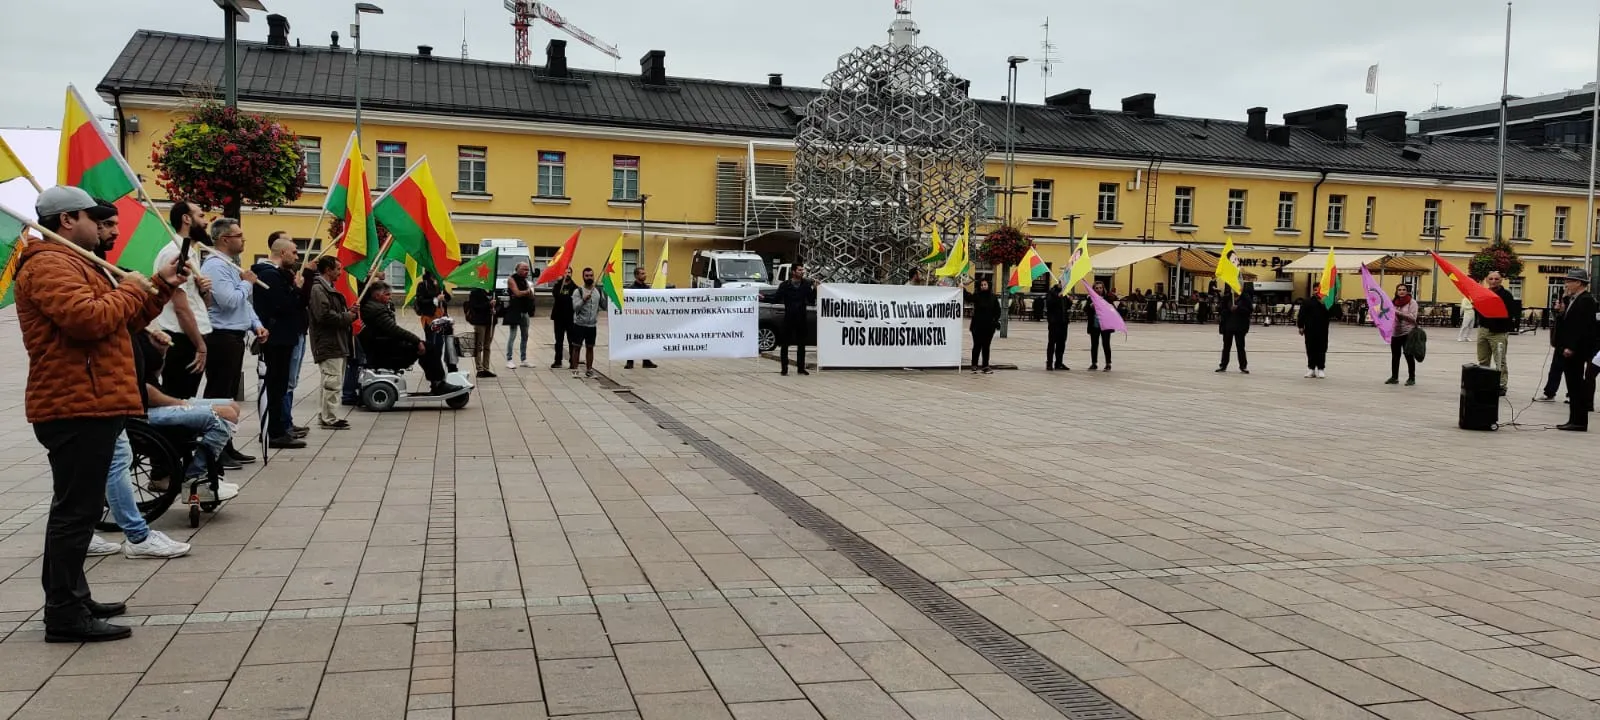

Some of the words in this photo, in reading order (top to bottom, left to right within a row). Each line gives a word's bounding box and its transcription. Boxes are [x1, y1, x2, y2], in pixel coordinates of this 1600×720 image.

[636, 296, 668, 304] ROJAVA,
[691, 306, 754, 314] HYÖKKÄYKSILLE!
[821, 298, 878, 319] Miehittäjät
[879, 300, 890, 319] ja
[891, 300, 924, 319] Turkin
[926, 301, 961, 319] armeija
[625, 333, 632, 341] JI
[645, 332, 700, 340] BERXWEDANA
[842, 327, 865, 346] POIS
[868, 327, 947, 346] KURDISTANISTA!
[681, 343, 708, 351] HILDE!
